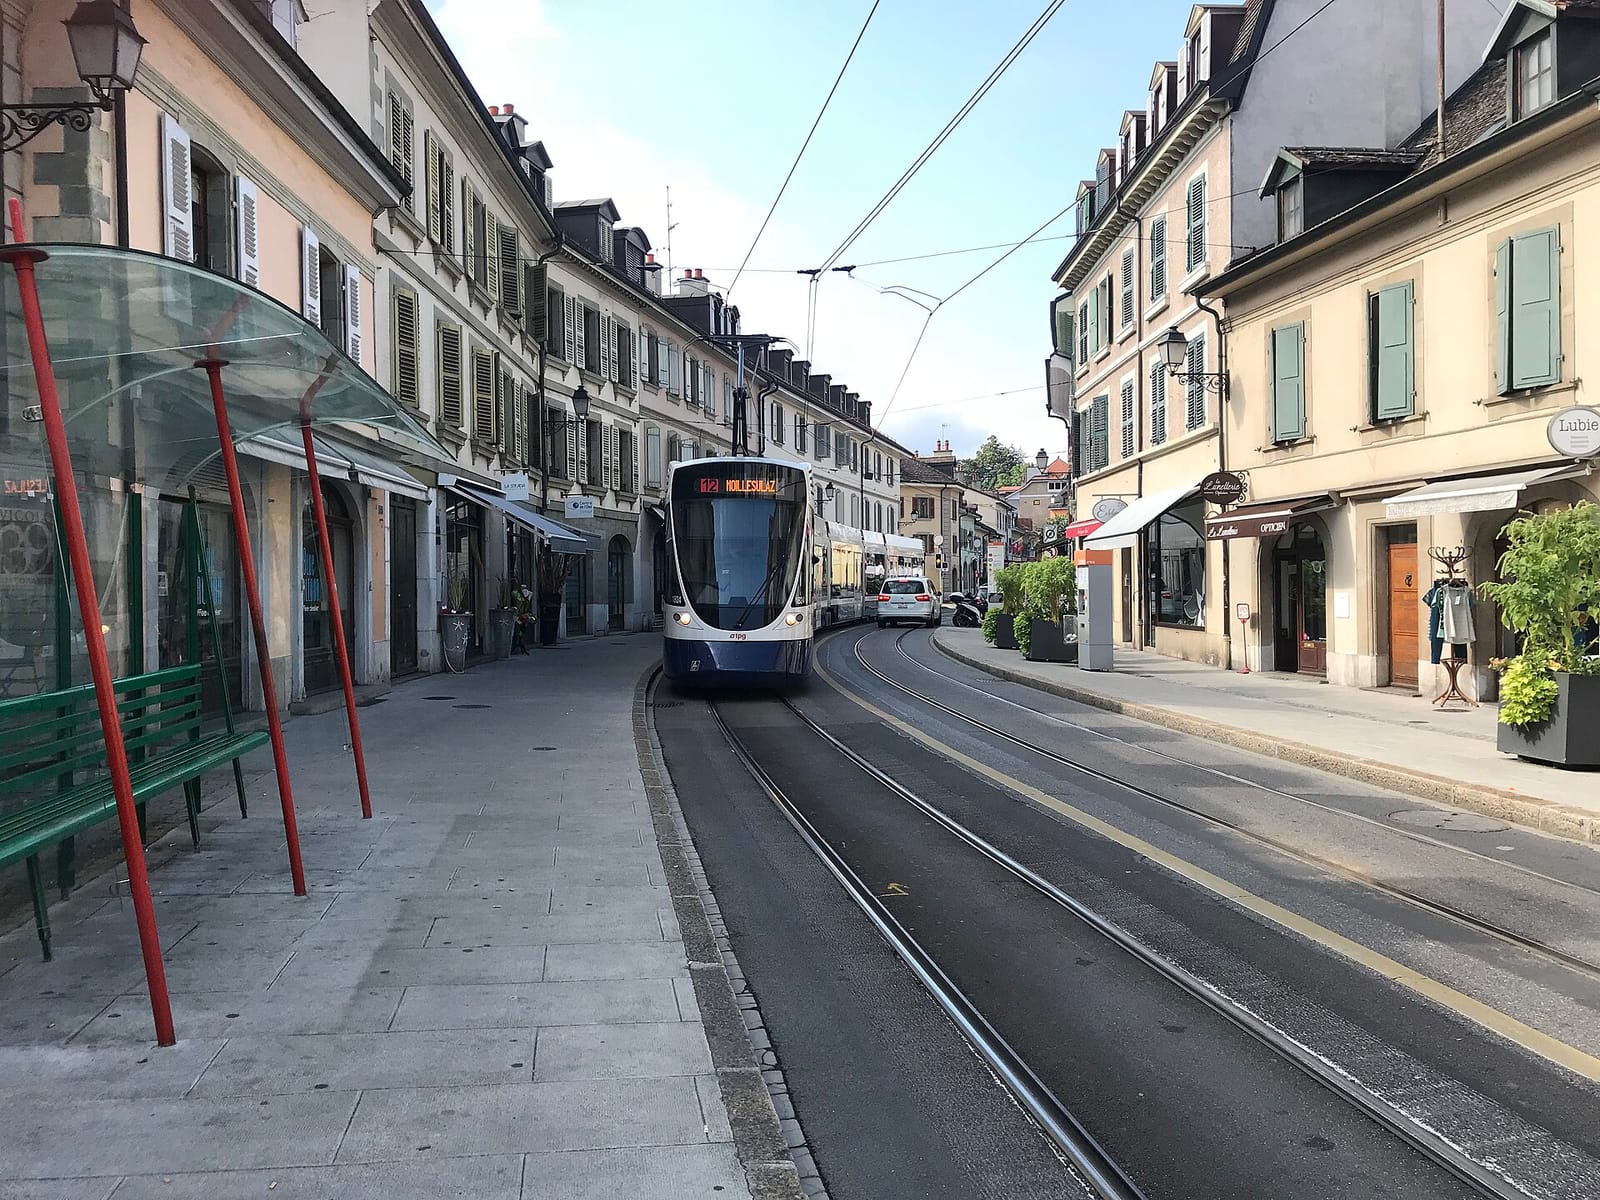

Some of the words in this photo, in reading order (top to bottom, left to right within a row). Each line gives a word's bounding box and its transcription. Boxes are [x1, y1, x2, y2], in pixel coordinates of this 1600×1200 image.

[1559, 418, 1599, 431] Lubie
[702, 479, 718, 492] 12
[726, 479, 775, 492] MOILLESULAZ
[1260, 521, 1286, 533] OPTICIEN
